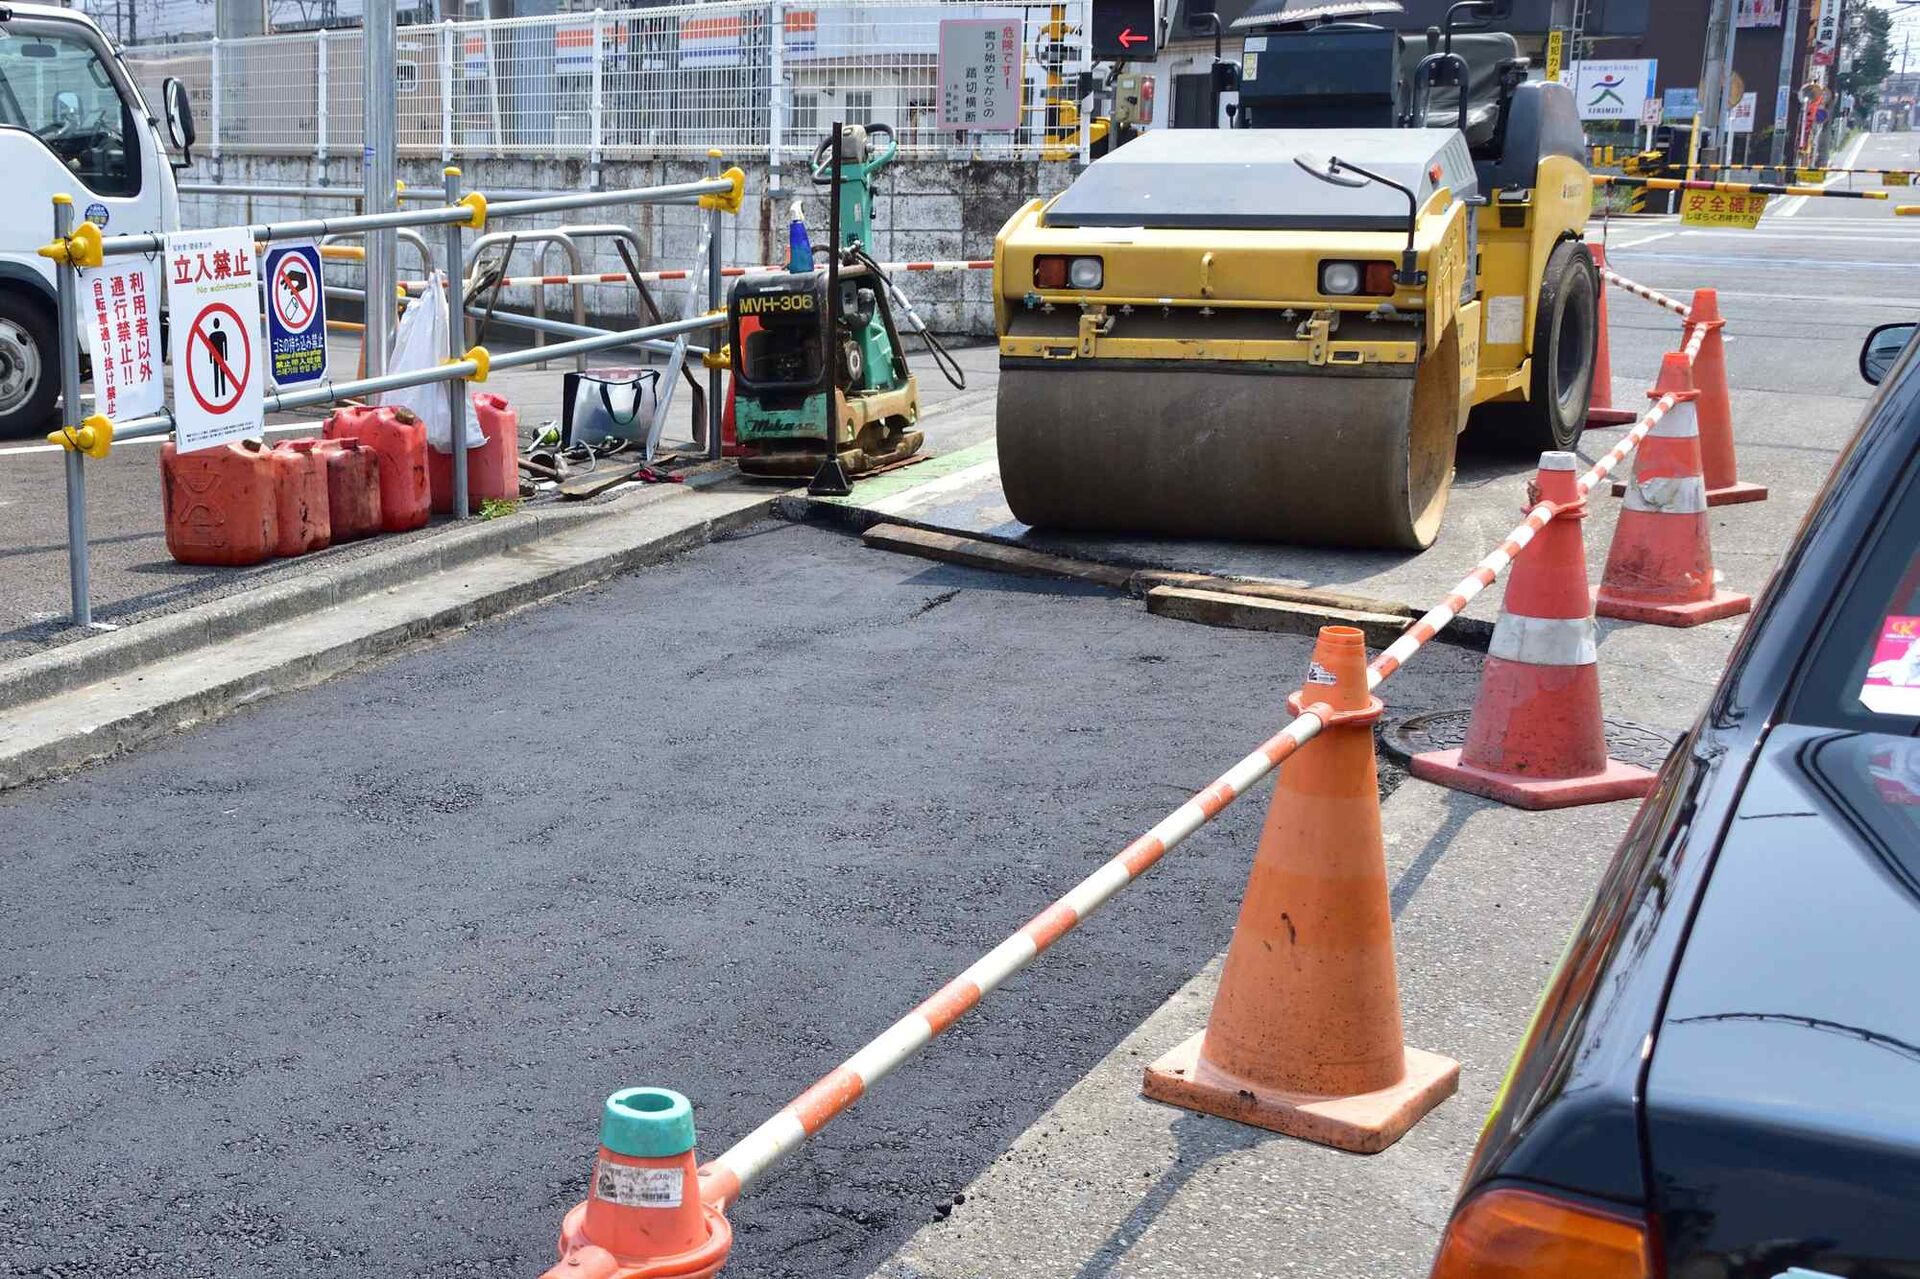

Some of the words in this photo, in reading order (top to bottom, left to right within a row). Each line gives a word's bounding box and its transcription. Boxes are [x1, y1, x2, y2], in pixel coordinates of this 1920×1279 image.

[965, 67, 977, 122] 踏切横断
[983, 30, 996, 118] 鳴り始めてからの
[1690, 194, 1766, 213] 安全確認
[173, 248, 251, 285] 立入禁止
[110, 275, 134, 386] 通行禁止!!
[129, 271, 153, 383] 利用者以外
[739, 294, 814, 314] MVH-306
